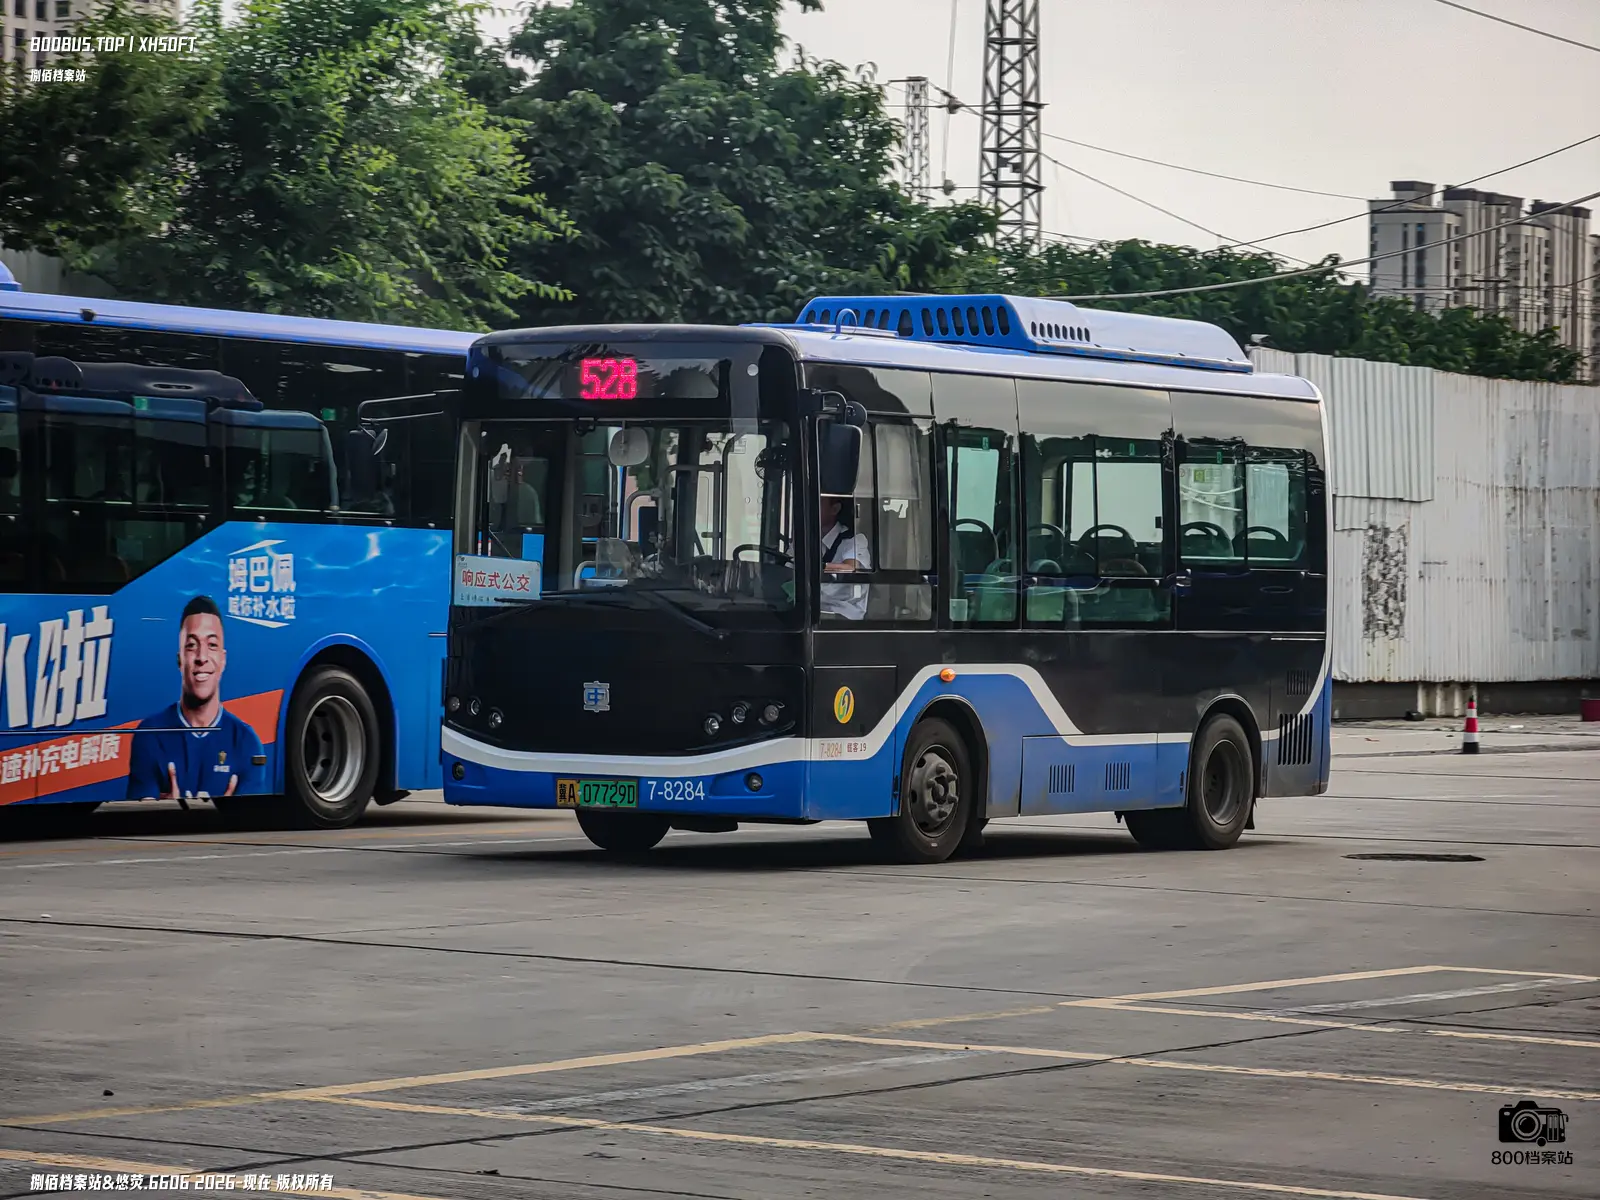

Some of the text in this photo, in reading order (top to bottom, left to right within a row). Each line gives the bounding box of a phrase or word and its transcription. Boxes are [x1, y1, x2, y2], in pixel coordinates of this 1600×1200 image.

[580, 357, 637, 399] 528
[462, 570, 530, 592] 响应式公交
[647, 780, 706, 801] 7-8284
